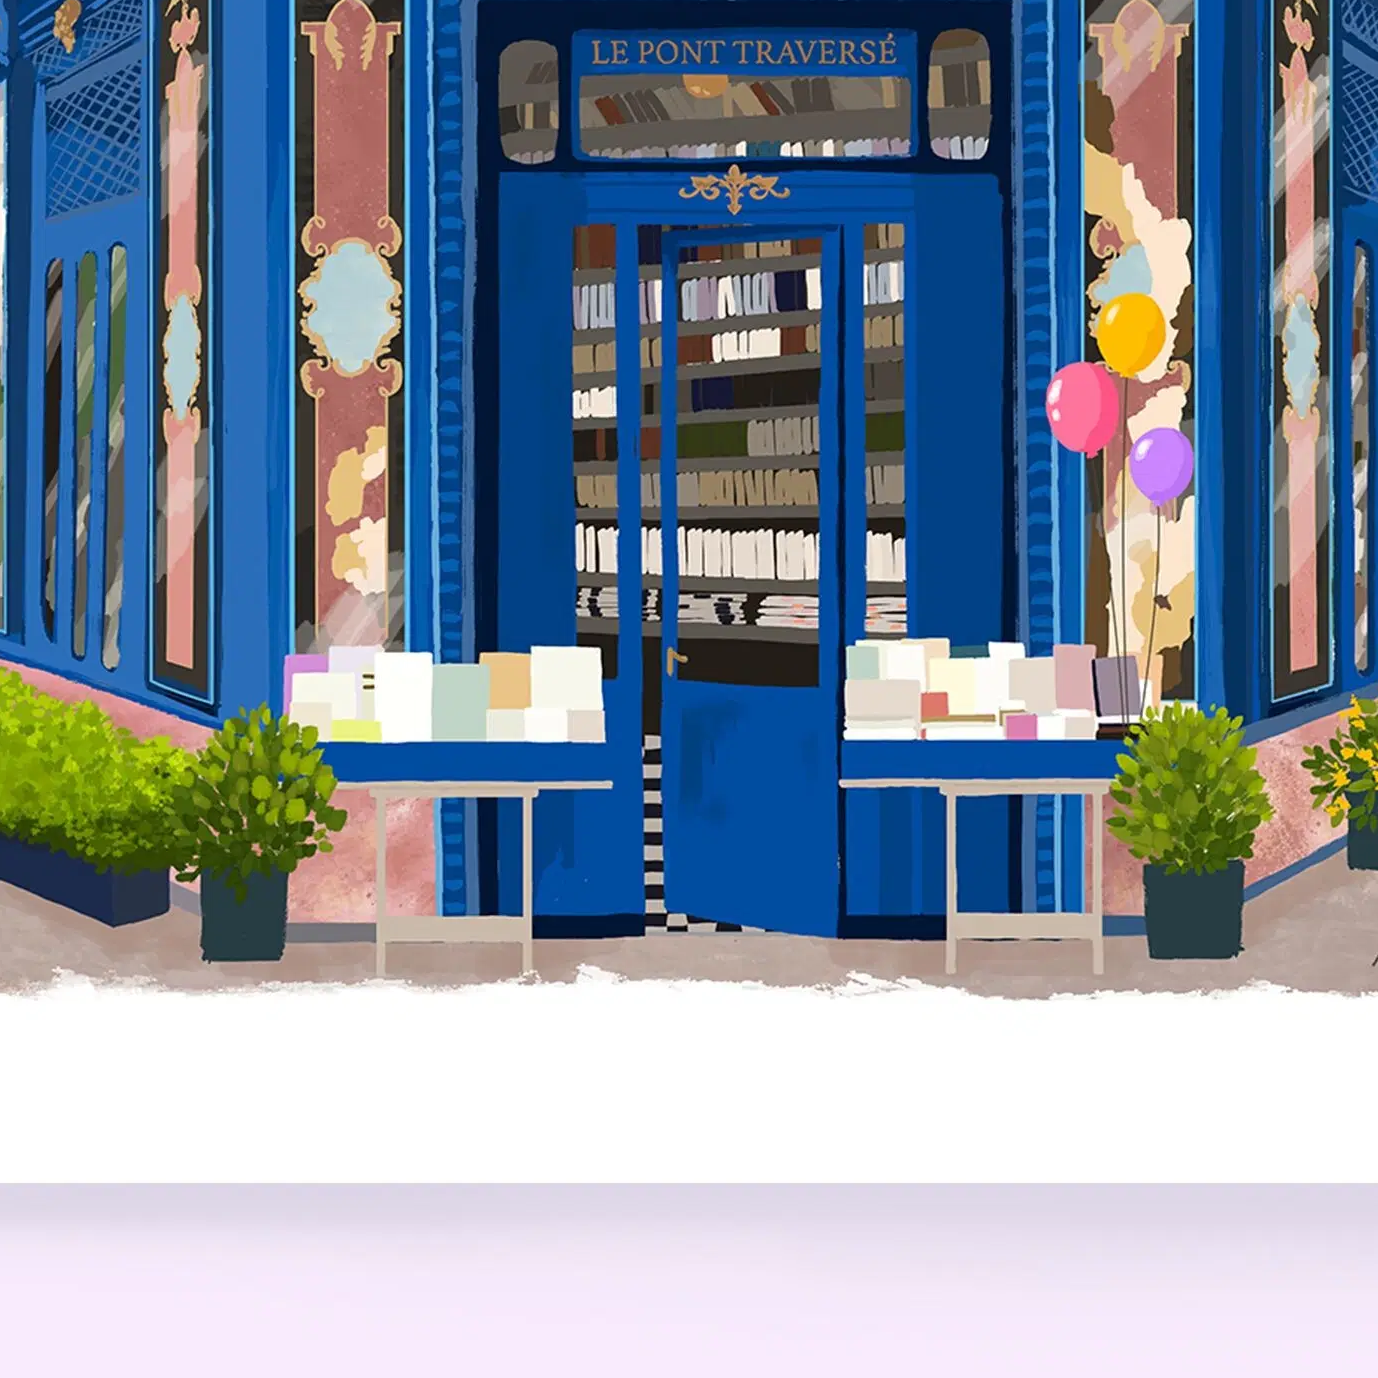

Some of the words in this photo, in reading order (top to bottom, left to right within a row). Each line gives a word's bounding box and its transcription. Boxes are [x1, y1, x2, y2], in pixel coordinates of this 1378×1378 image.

[591, 39, 629, 66] LE
[638, 39, 726, 66] PONT
[731, 32, 898, 66] TRAVERSÉ
